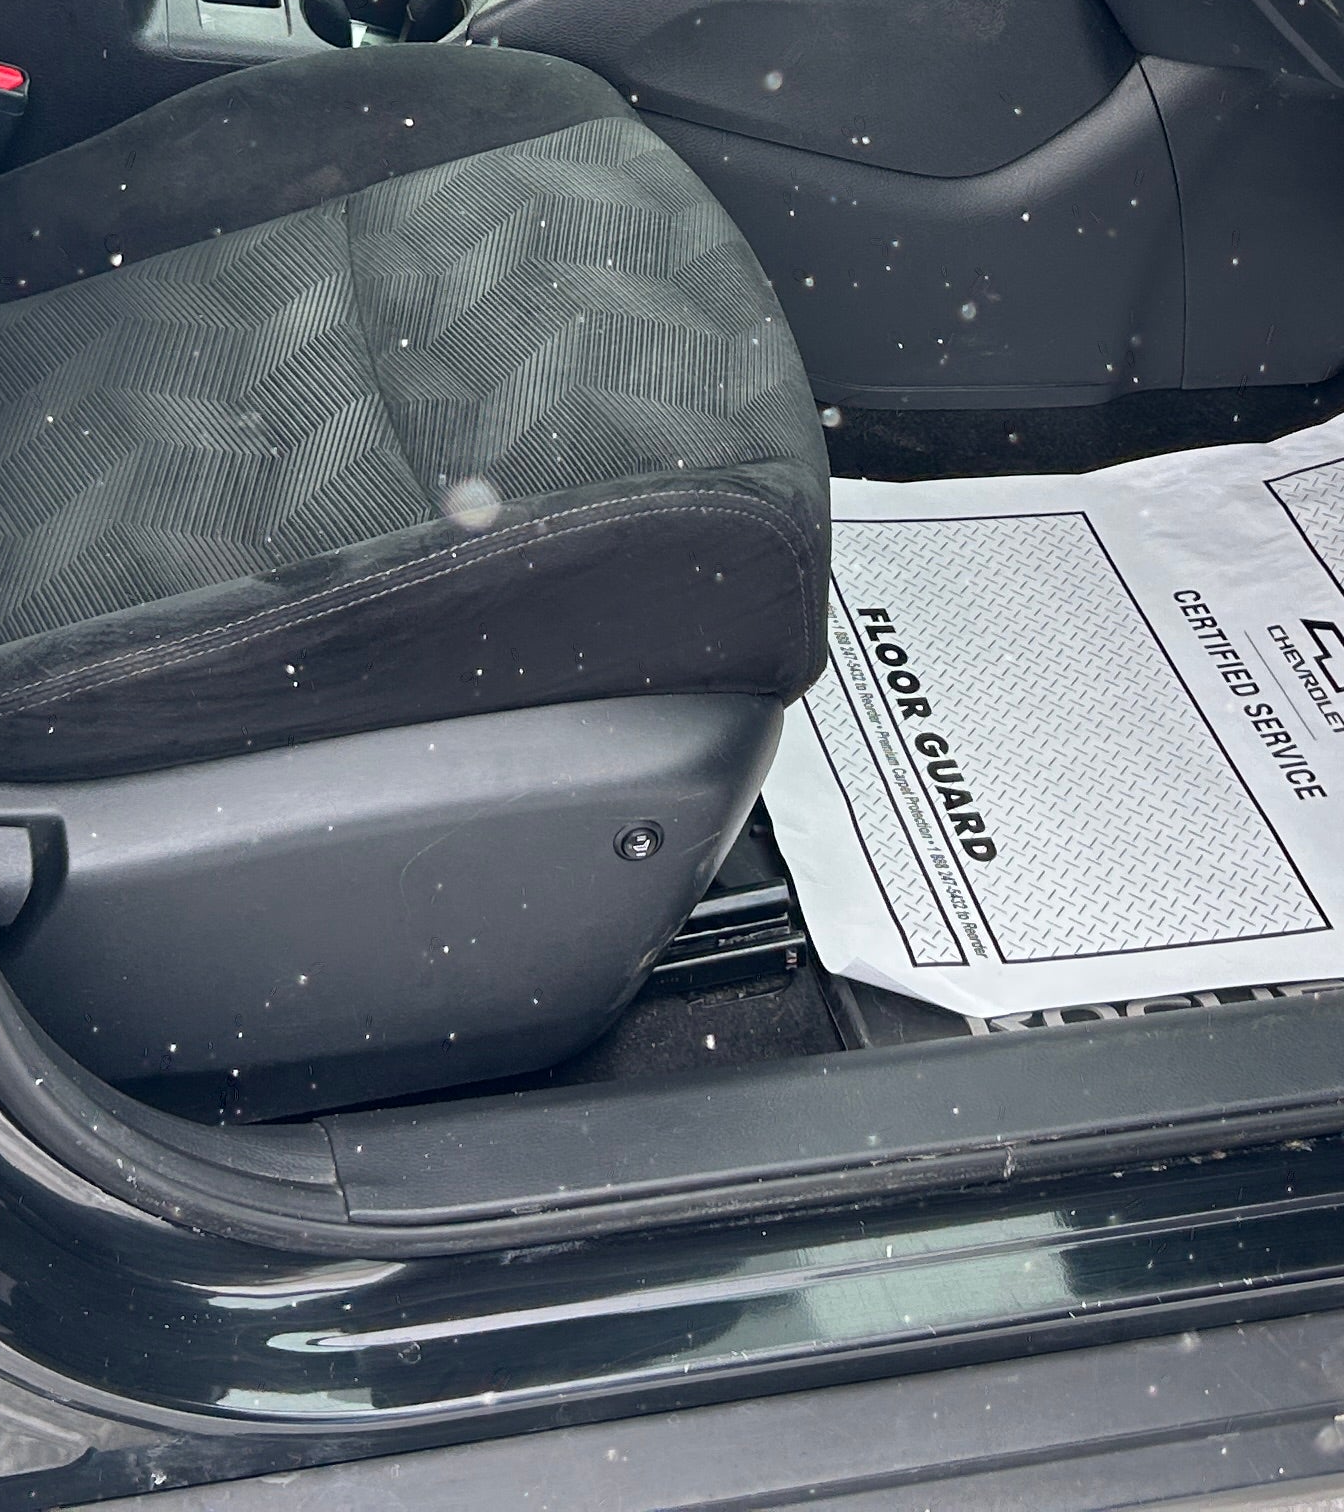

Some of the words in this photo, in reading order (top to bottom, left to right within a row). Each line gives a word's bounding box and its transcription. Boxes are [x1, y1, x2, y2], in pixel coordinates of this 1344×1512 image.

[856, 608, 933, 721] FLOOR
[914, 732, 998, 863] GUARD
[1172, 589, 1261, 698] CERTIFIED
[1243, 702, 1329, 801] SERVICE
[891, 767, 914, 795] Carpet
[904, 795, 933, 840] Protection
